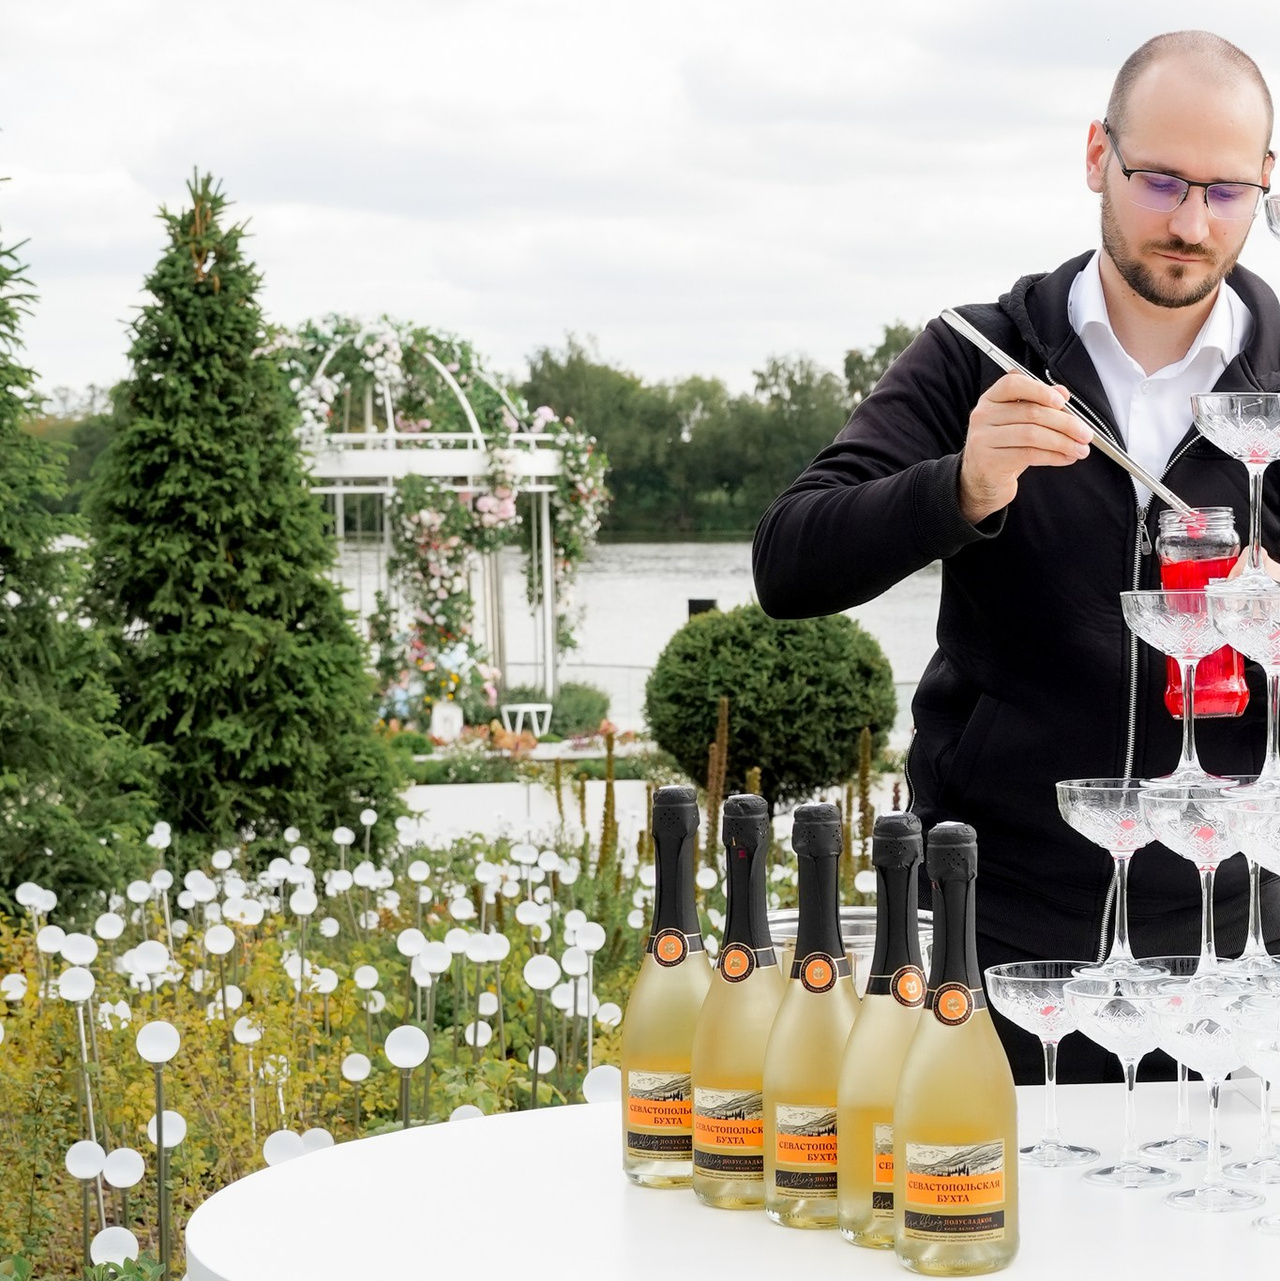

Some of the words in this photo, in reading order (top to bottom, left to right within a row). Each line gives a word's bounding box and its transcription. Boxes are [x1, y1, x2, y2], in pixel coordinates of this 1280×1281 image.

[653, 1117, 683, 1125] БУХТА
[716, 1136, 745, 1145] БУХТА
[807, 1153, 837, 1161] БУХТА
[908, 1179, 1000, 1192] СЕВАСТОПОЛЬСКАЯ
[937, 1194, 970, 1202] БУХТА
